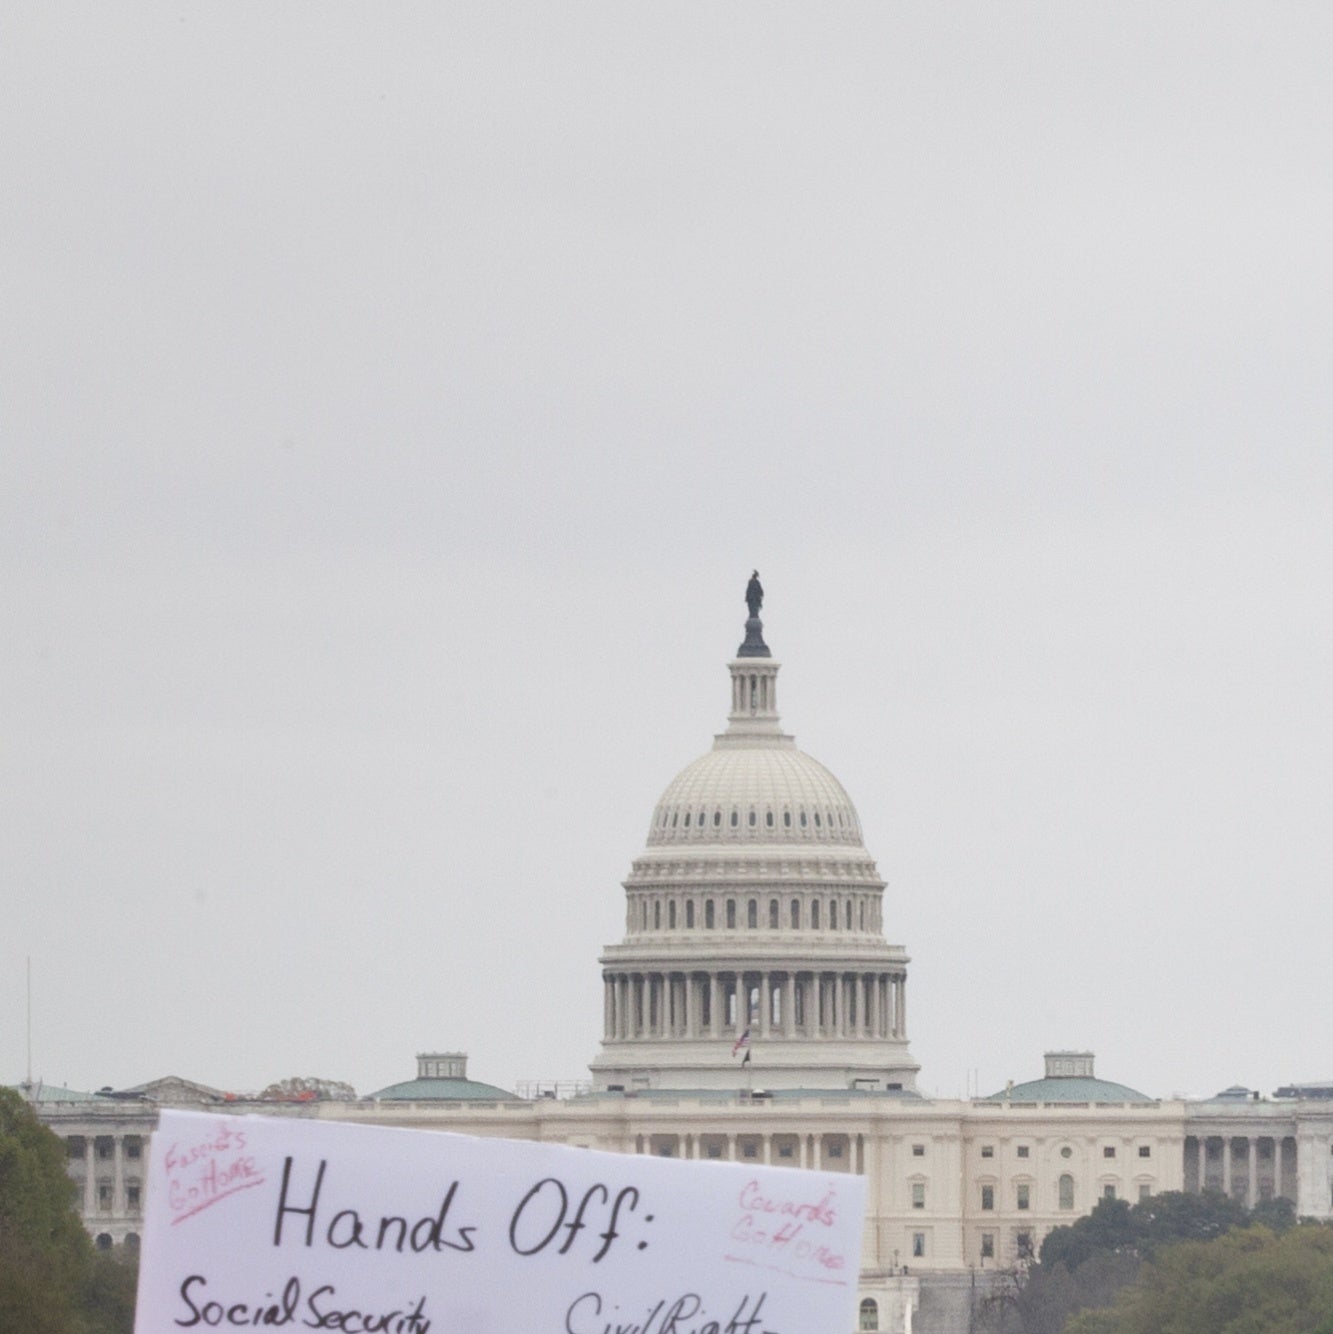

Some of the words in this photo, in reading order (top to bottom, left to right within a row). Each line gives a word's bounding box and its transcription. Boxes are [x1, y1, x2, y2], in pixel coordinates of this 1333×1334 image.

[273, 1155, 477, 1253] Hands
[508, 1177, 655, 1264] Off:
[174, 1275, 301, 1328] Social
